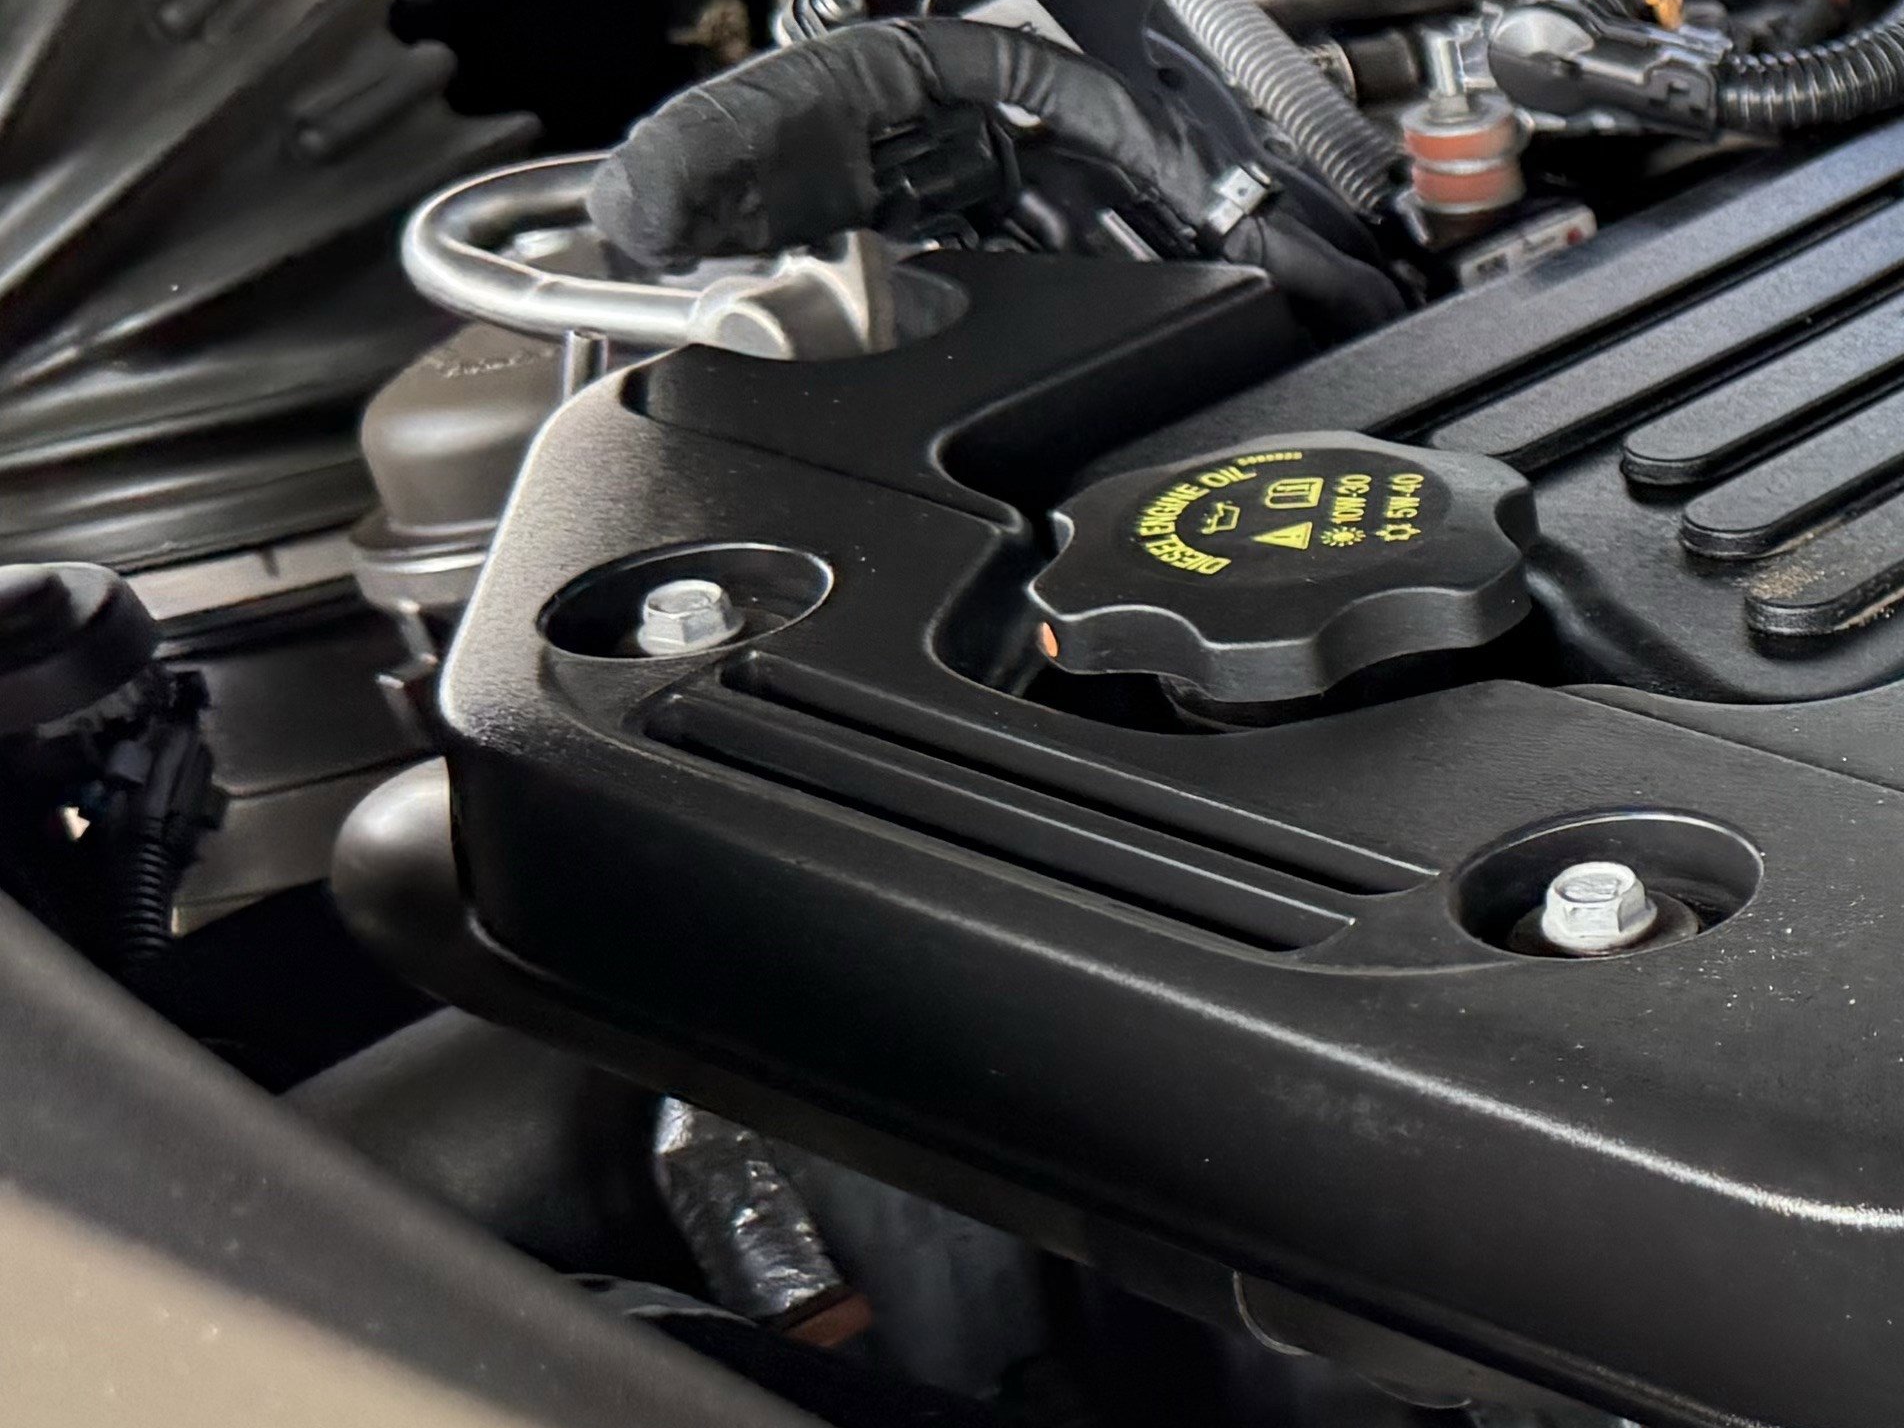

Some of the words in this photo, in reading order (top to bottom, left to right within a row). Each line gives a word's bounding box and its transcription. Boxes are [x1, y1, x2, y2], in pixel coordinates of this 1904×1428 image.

[1198, 465, 1257, 488] OIL
[1331, 473, 1372, 525] 10W-30
[1384, 473, 1425, 518] 5W-40
[1138, 483, 1211, 536] ENGINE
[1145, 533, 1232, 575] DIESEL
